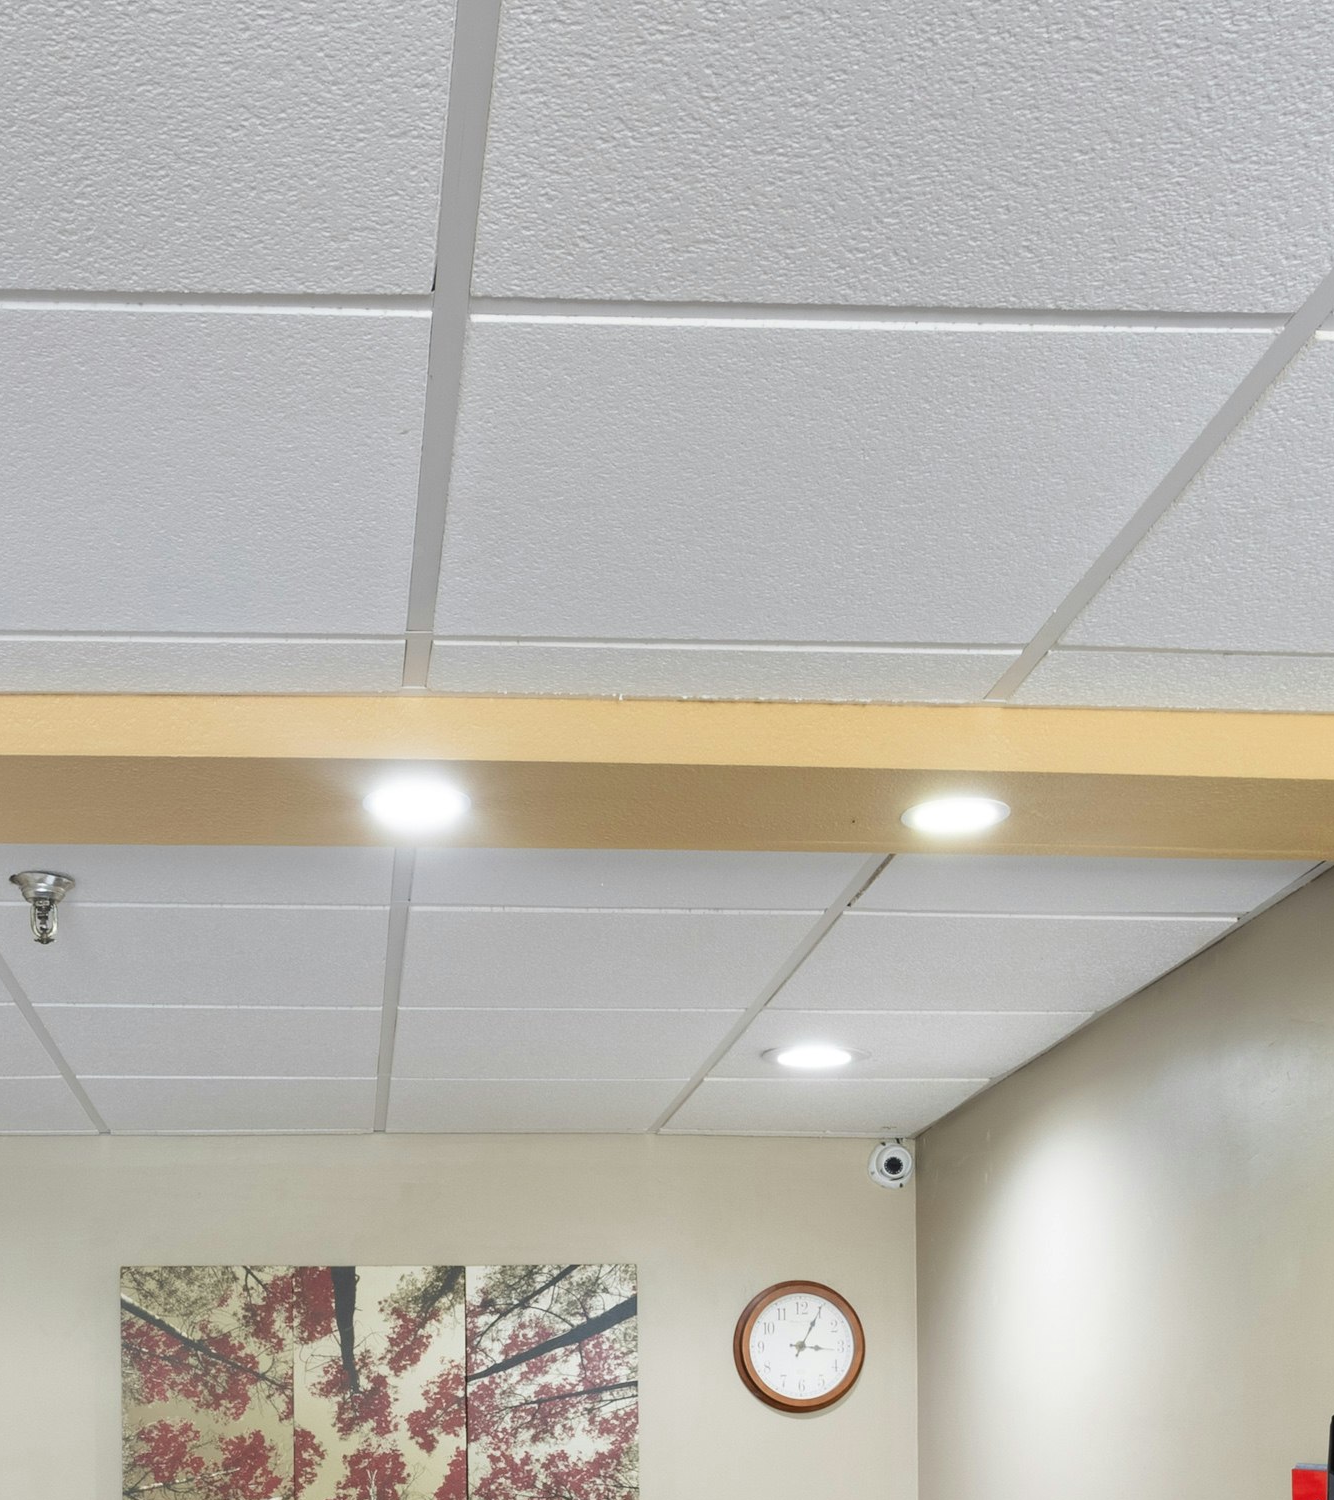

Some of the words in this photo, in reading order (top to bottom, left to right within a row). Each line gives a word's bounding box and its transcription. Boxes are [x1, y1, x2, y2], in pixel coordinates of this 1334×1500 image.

[777, 1308, 786, 1321] 11
[795, 1301, 808, 1315] 12
[763, 1322, 775, 1335] 10
[830, 1320, 838, 1333] 2
[758, 1341, 765, 1353] 9
[837, 1340, 844, 1353] 3
[798, 1379, 805, 1392] 6
